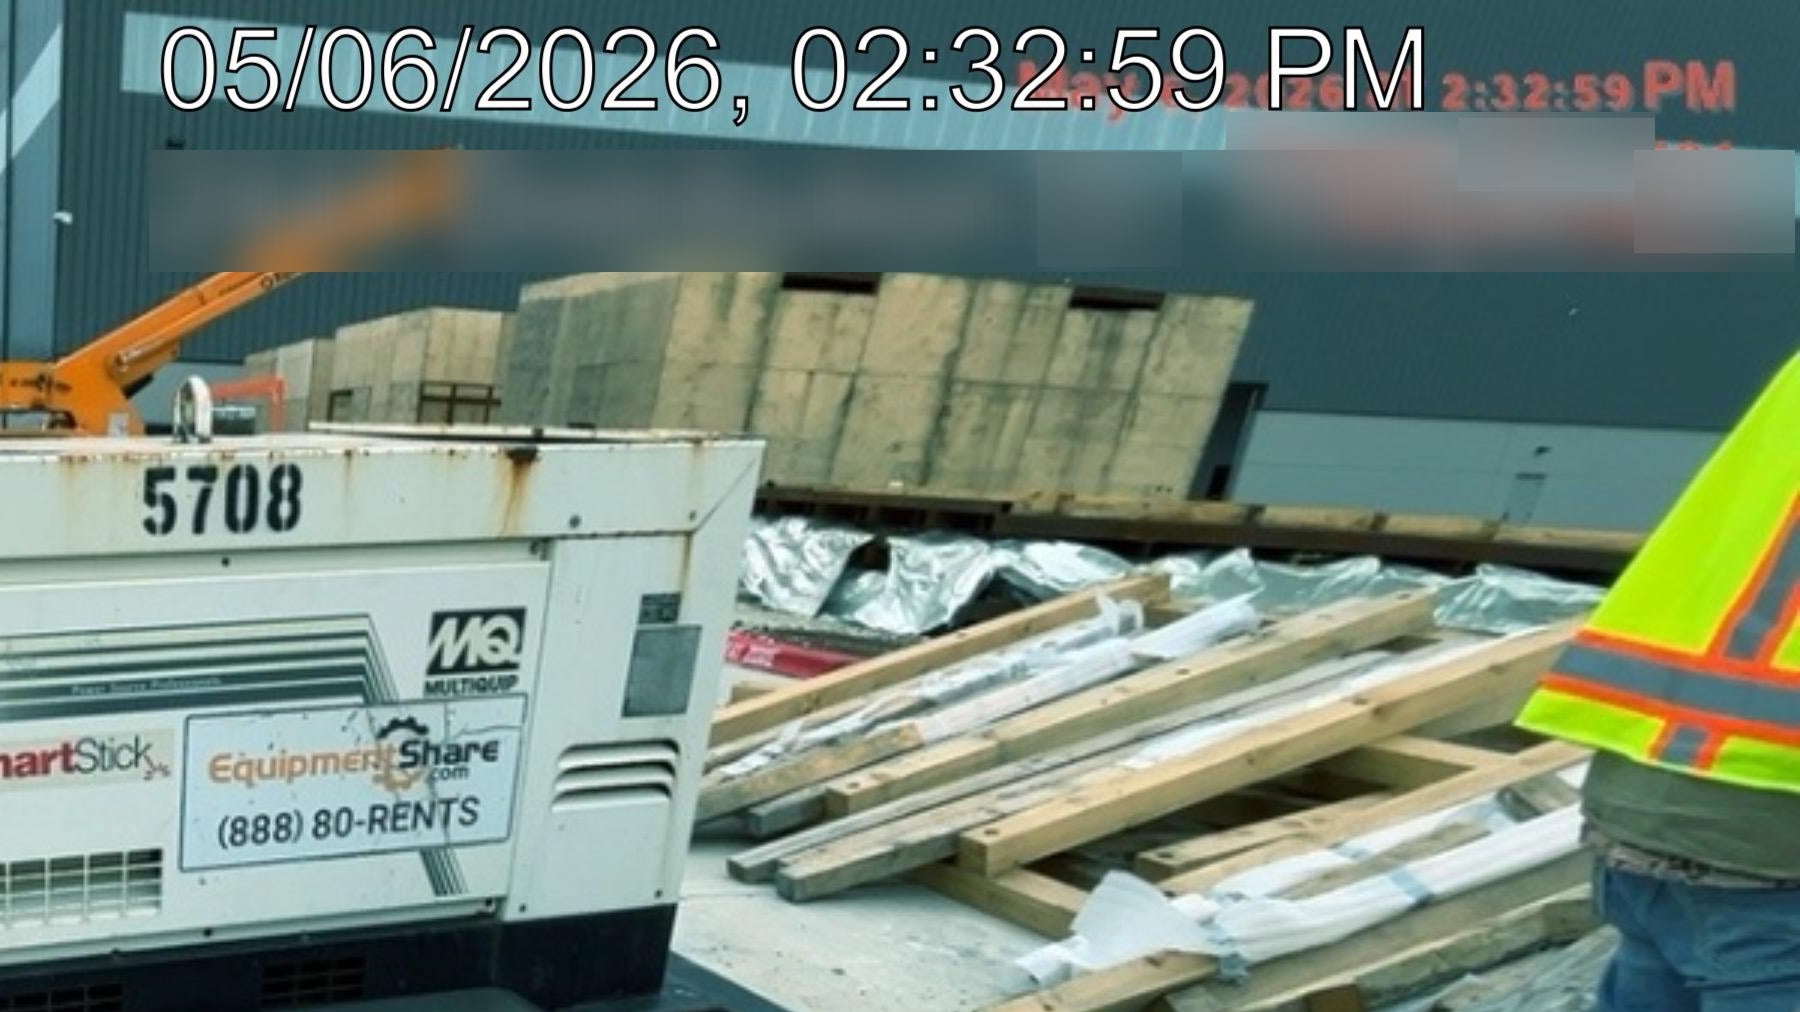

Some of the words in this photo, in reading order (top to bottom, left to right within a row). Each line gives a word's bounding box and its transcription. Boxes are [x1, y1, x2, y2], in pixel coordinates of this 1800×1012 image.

[143, 464, 303, 535] 5708
[428, 613, 522, 670] MQ
[425, 674, 520, 695] MULTIQUIP
[218, 810, 304, 850] (888)
[311, 796, 481, 840] 80-RENTS
